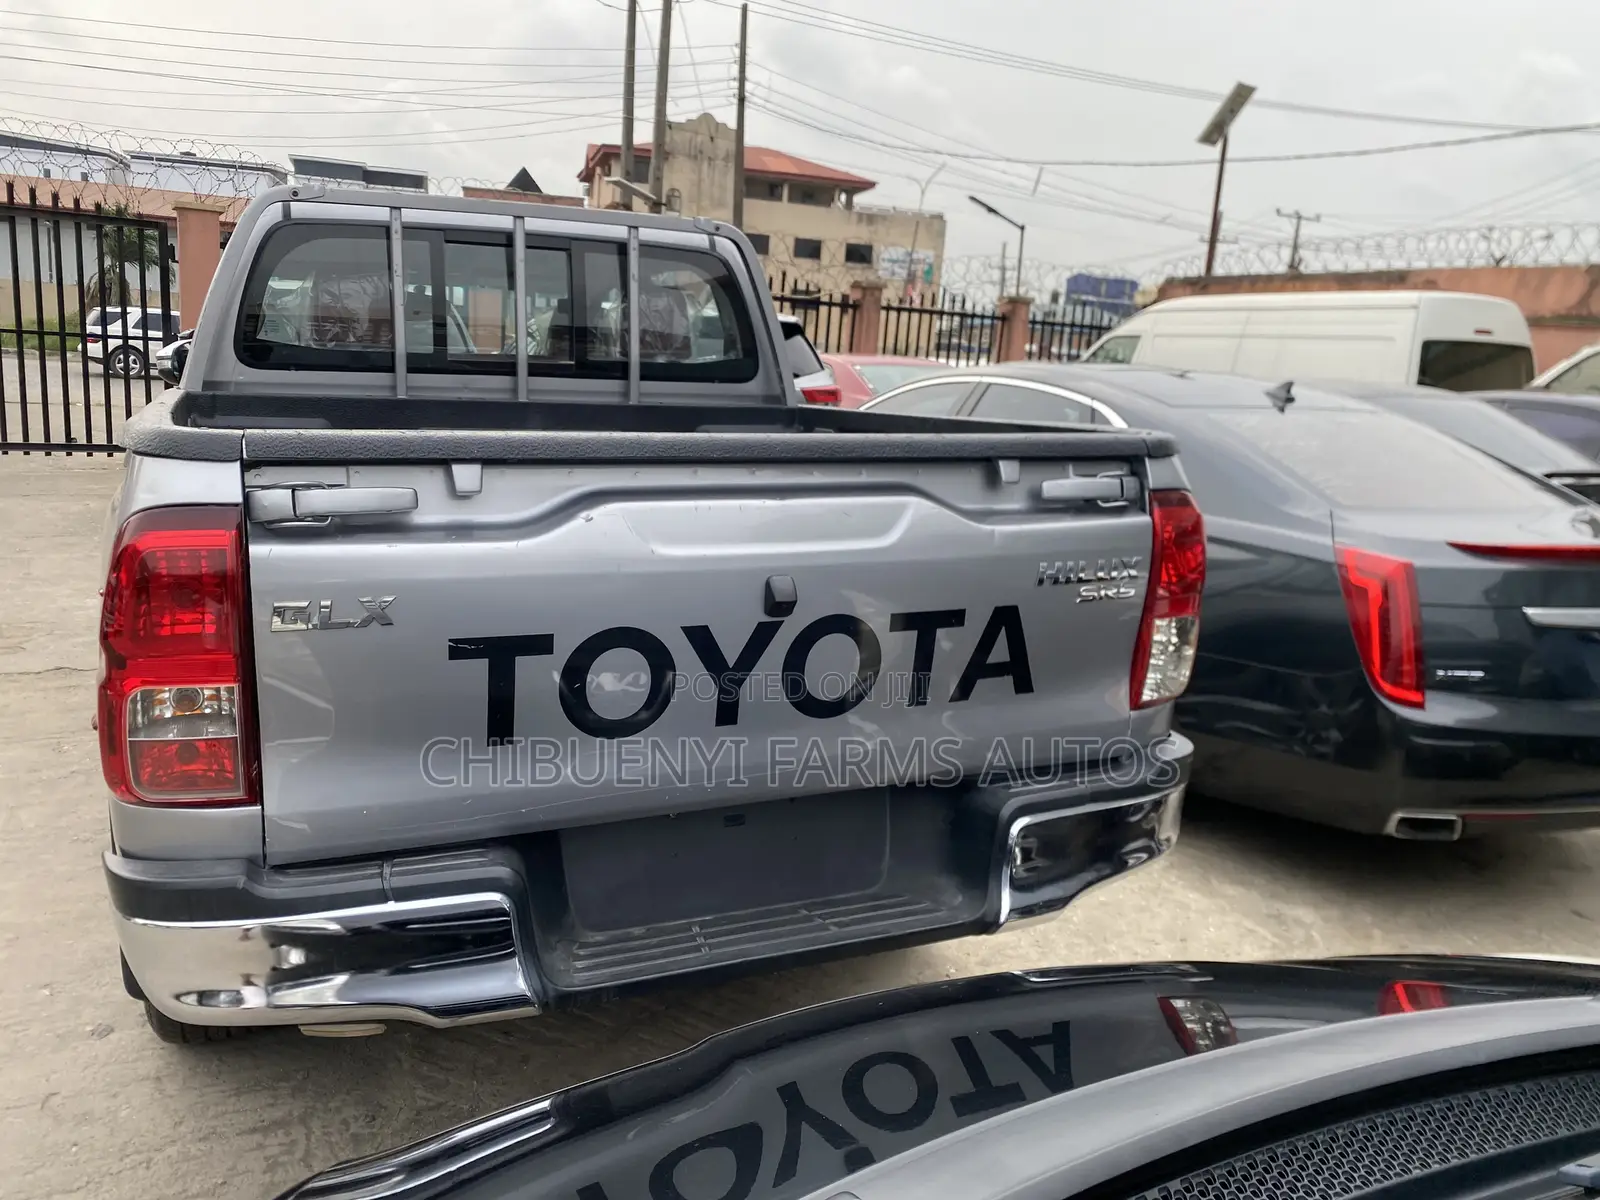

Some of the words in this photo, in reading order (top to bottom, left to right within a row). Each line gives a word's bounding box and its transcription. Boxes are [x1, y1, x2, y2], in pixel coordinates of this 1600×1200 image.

[1037, 557, 1142, 586] HILUX
[270, 595, 397, 632] GLX
[448, 605, 1034, 746] TOYOTA
